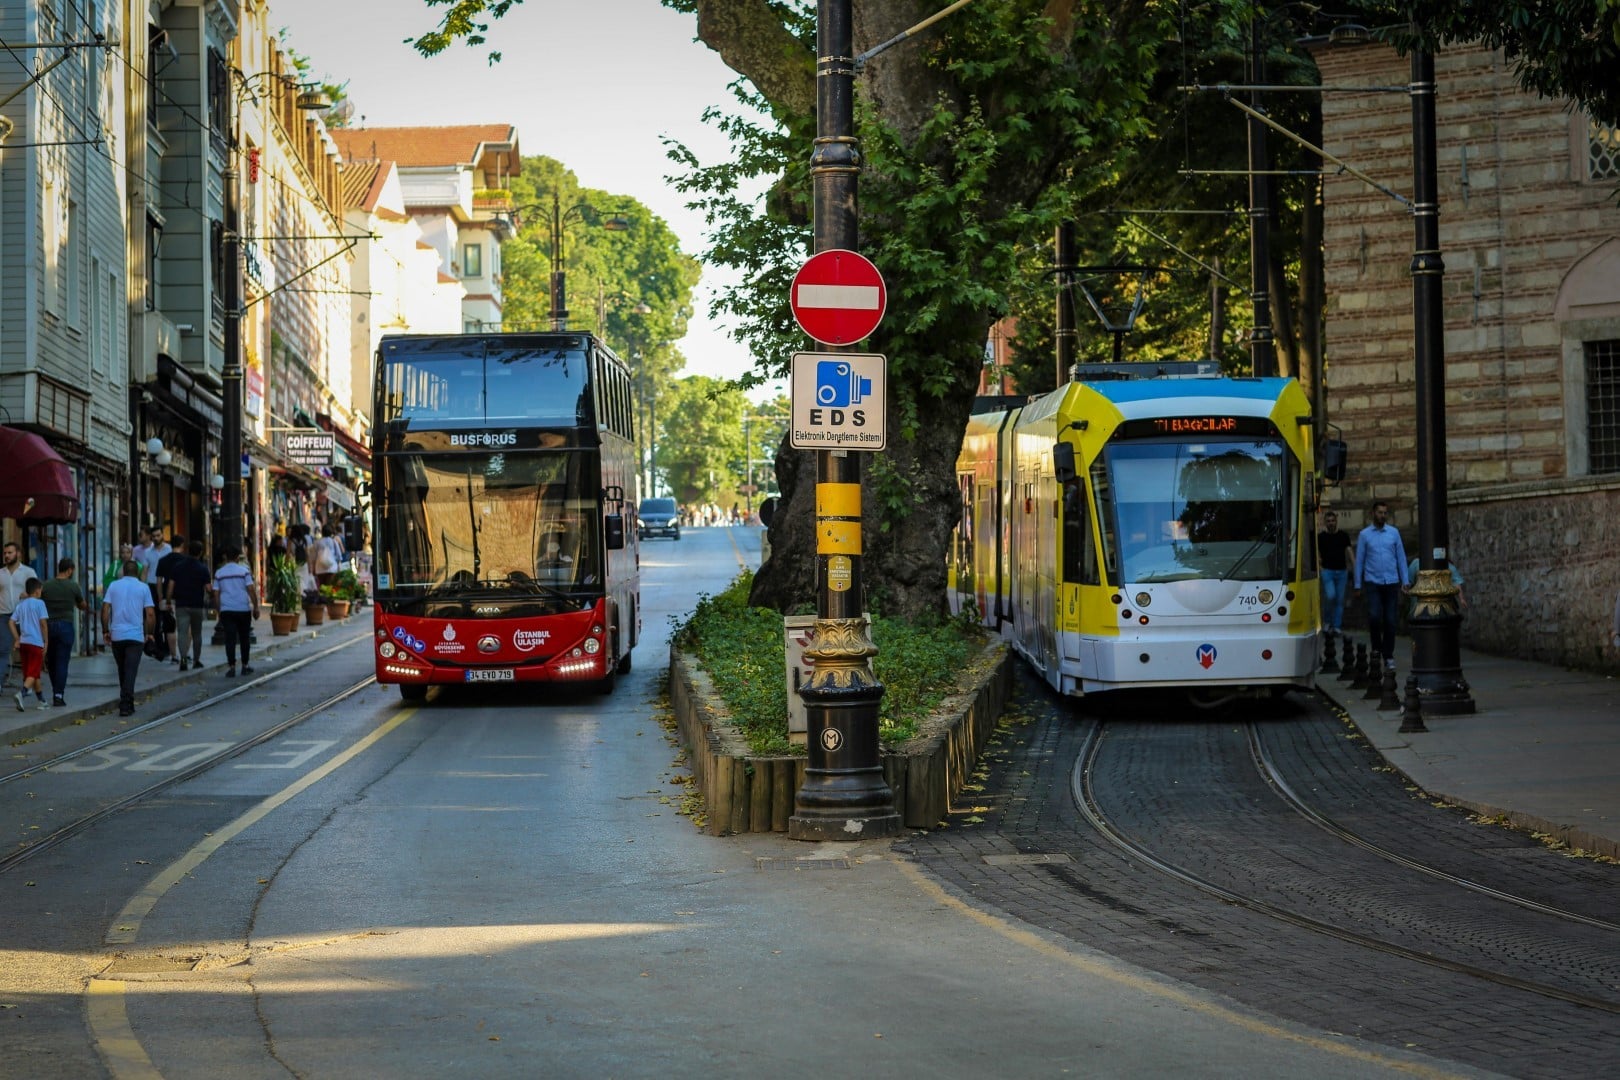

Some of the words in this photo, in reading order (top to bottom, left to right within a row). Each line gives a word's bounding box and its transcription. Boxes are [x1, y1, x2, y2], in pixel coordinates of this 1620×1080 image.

[450, 433, 517, 446] BUSFORUS
[795, 431, 826, 441] Elektronik
[859, 433, 882, 442] Sistemi
[1238, 596, 1257, 605] 740
[470, 671, 479, 680] 34
[498, 670, 512, 679] 719
